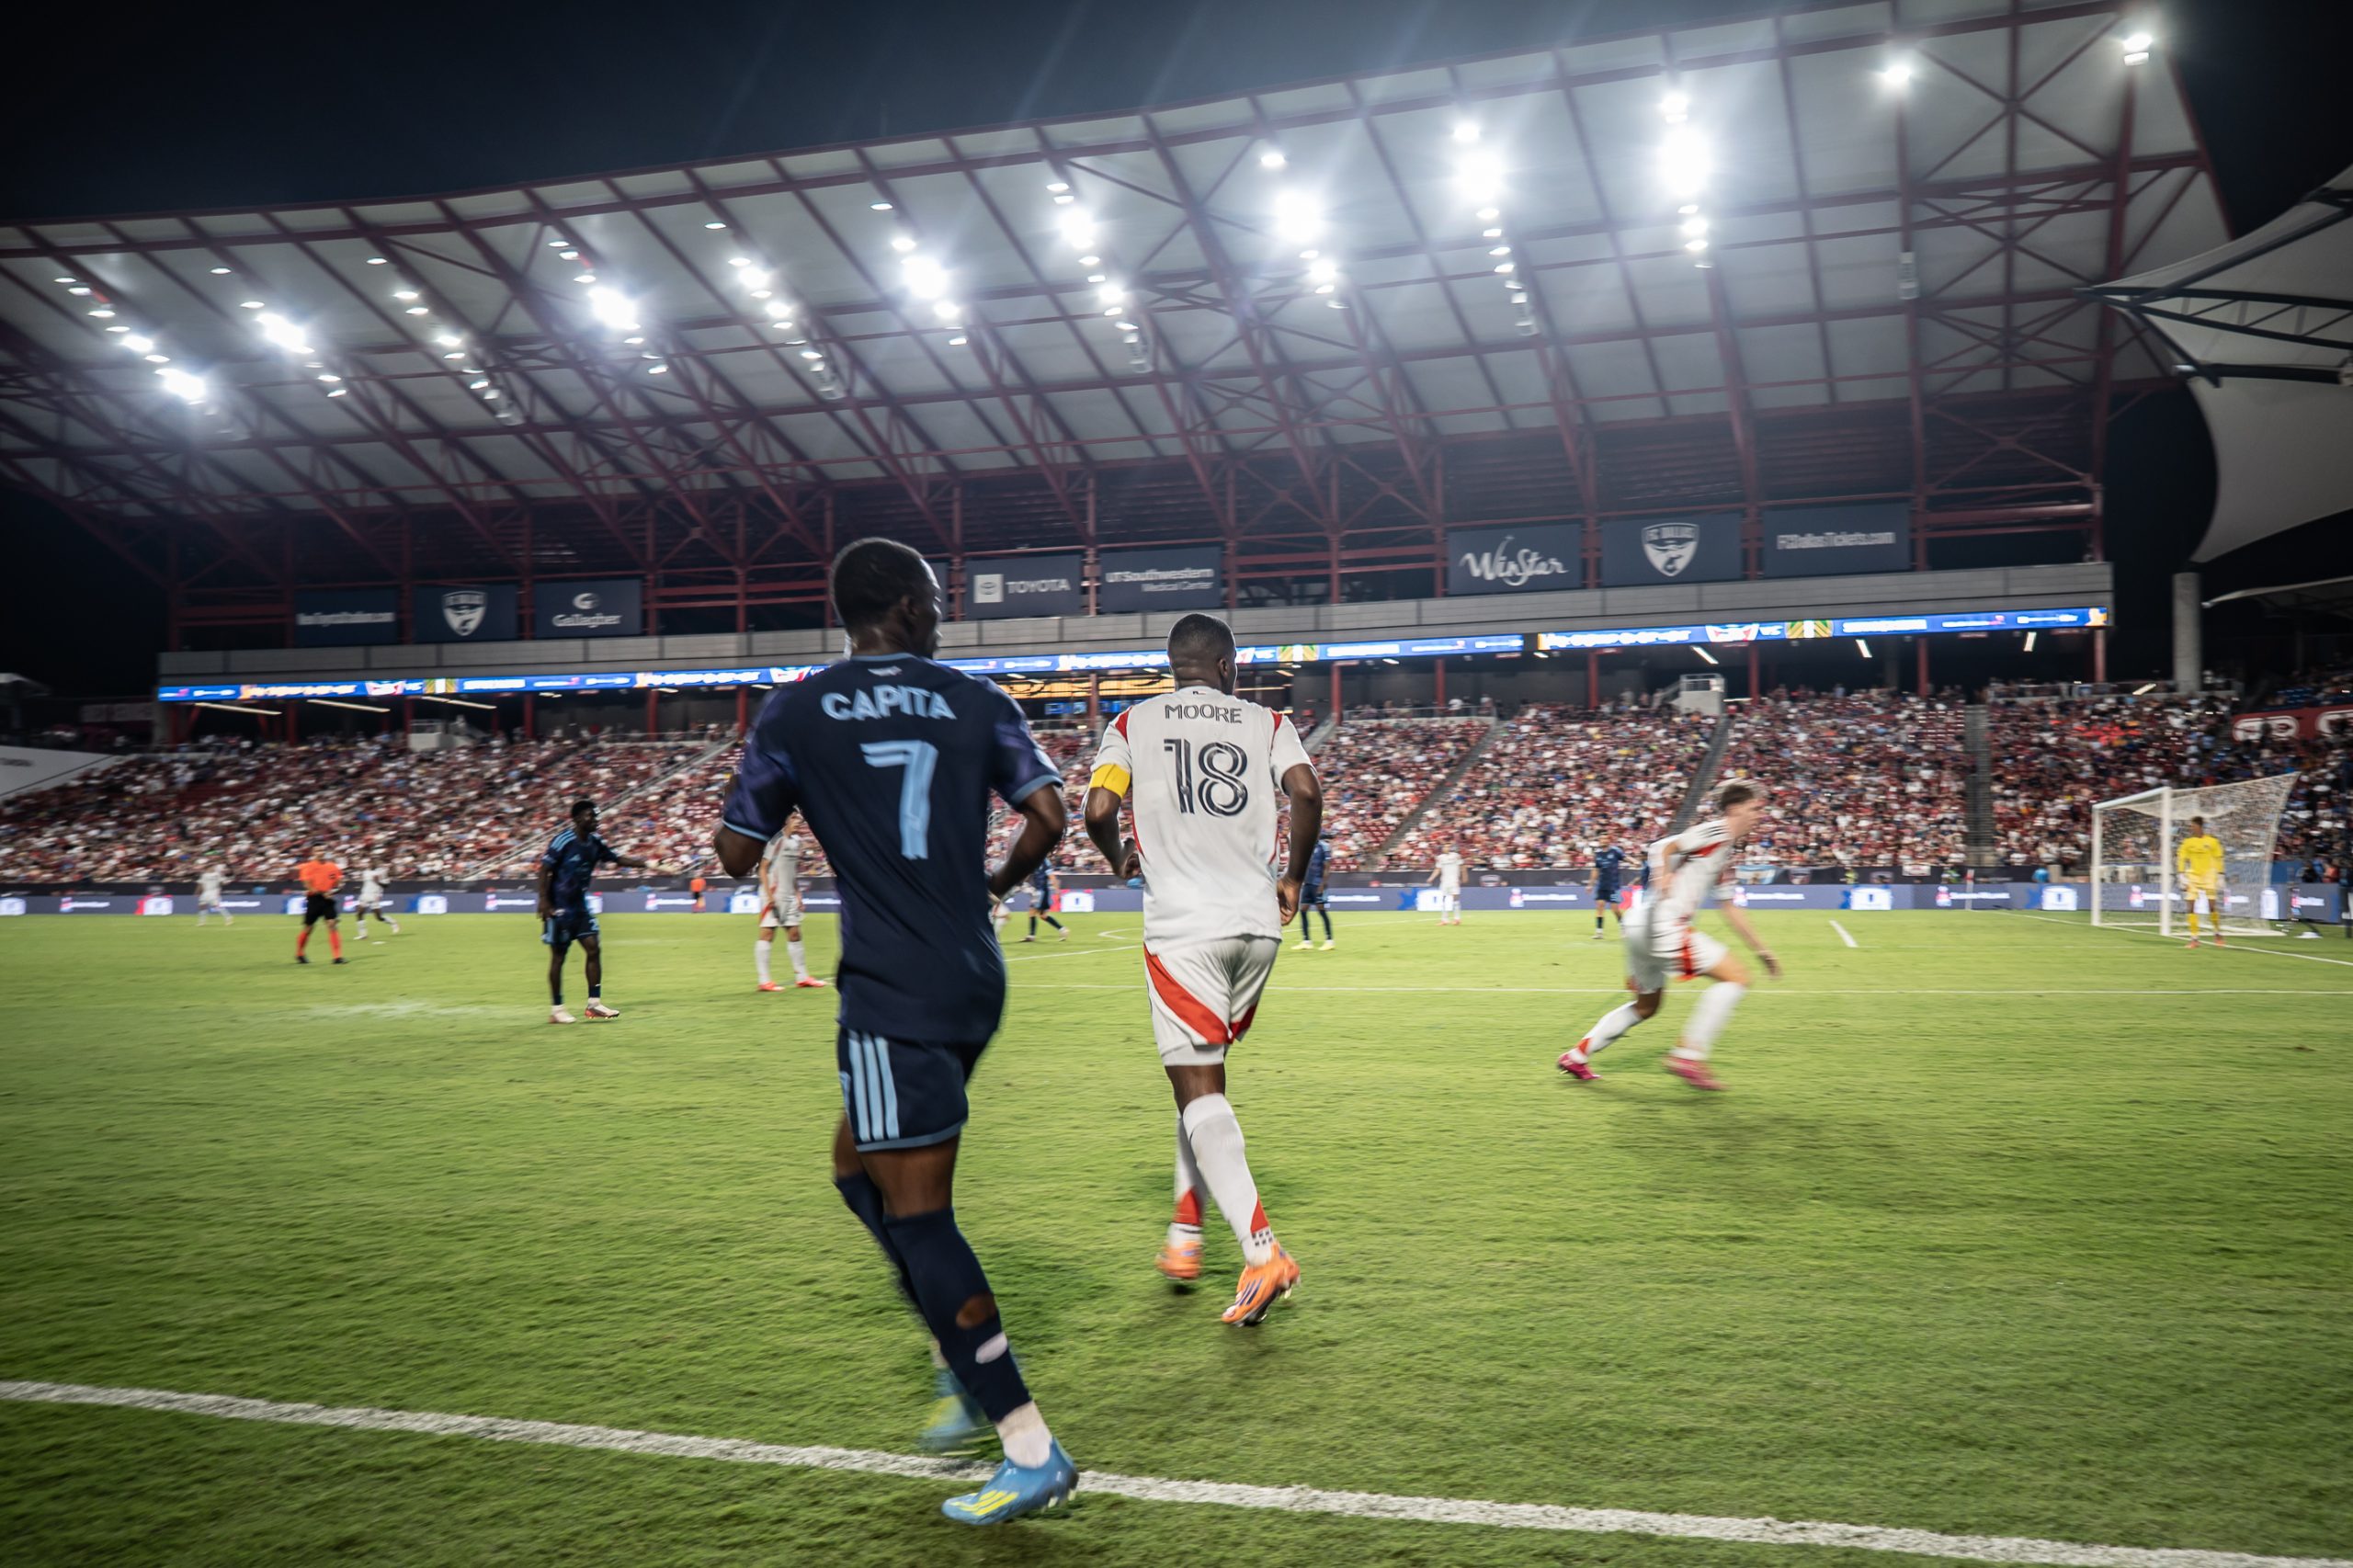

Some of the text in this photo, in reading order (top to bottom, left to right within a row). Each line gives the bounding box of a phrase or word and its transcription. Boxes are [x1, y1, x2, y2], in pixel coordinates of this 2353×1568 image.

[1460, 534, 1570, 586] WinStar
[1006, 578, 1071, 594] TOYOTA
[552, 613, 621, 628] Gallagher
[820, 683, 956, 722] CAPITA
[1164, 703, 1243, 723] MOORE
[1164, 738, 1249, 817] 18
[859, 739, 939, 860] 7
